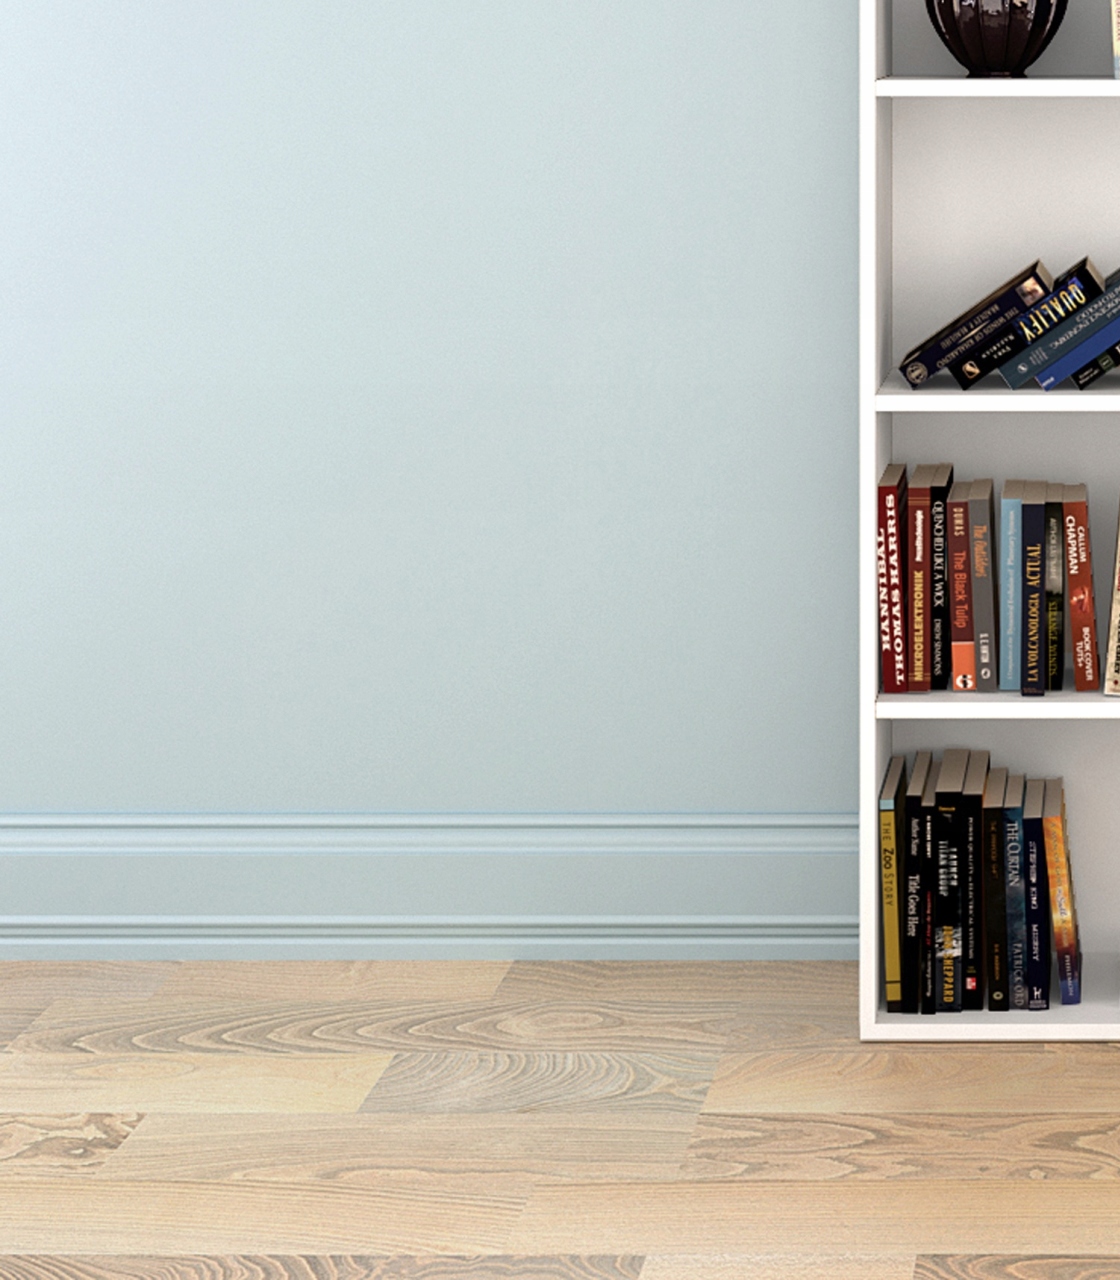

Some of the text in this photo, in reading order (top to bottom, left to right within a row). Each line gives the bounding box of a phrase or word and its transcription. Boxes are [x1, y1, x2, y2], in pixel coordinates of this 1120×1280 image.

[1019, 283, 1087, 342] QUALIFY
[932, 500, 944, 551] QUENCHED
[953, 507, 964, 537] DUMAS
[1066, 515, 1079, 574] CHAPMAN
[1077, 526, 1086, 562] CALLUM
[933, 552, 943, 571] LIKE
[973, 525, 989, 578] The Outsiders
[1026, 543, 1042, 588] ACTUAL
[886, 494, 904, 685] THOMAS HARRIS
[933, 582, 944, 607] WICK
[953, 550, 969, 628] The Black Tulip
[913, 571, 924, 682] MIKROELEKTRONIK
[933, 618, 942, 640] DREW
[1027, 592, 1040, 668] VOLCANOLOGIA
[1048, 601, 1057, 676] STRANGE WINDS
[1027, 668, 1039, 682] LA
[1076, 640, 1084, 668] TUTS+
[1082, 627, 1093, 681] BOOK COVER
[1006, 821, 1019, 841] THE
[882, 822, 895, 907] THE Zoo STORY
[907, 874, 919, 937] Title Goes Here
[942, 953, 954, 1003] SHEPPARD
[1012, 942, 1024, 1006] PATRICK ORD
